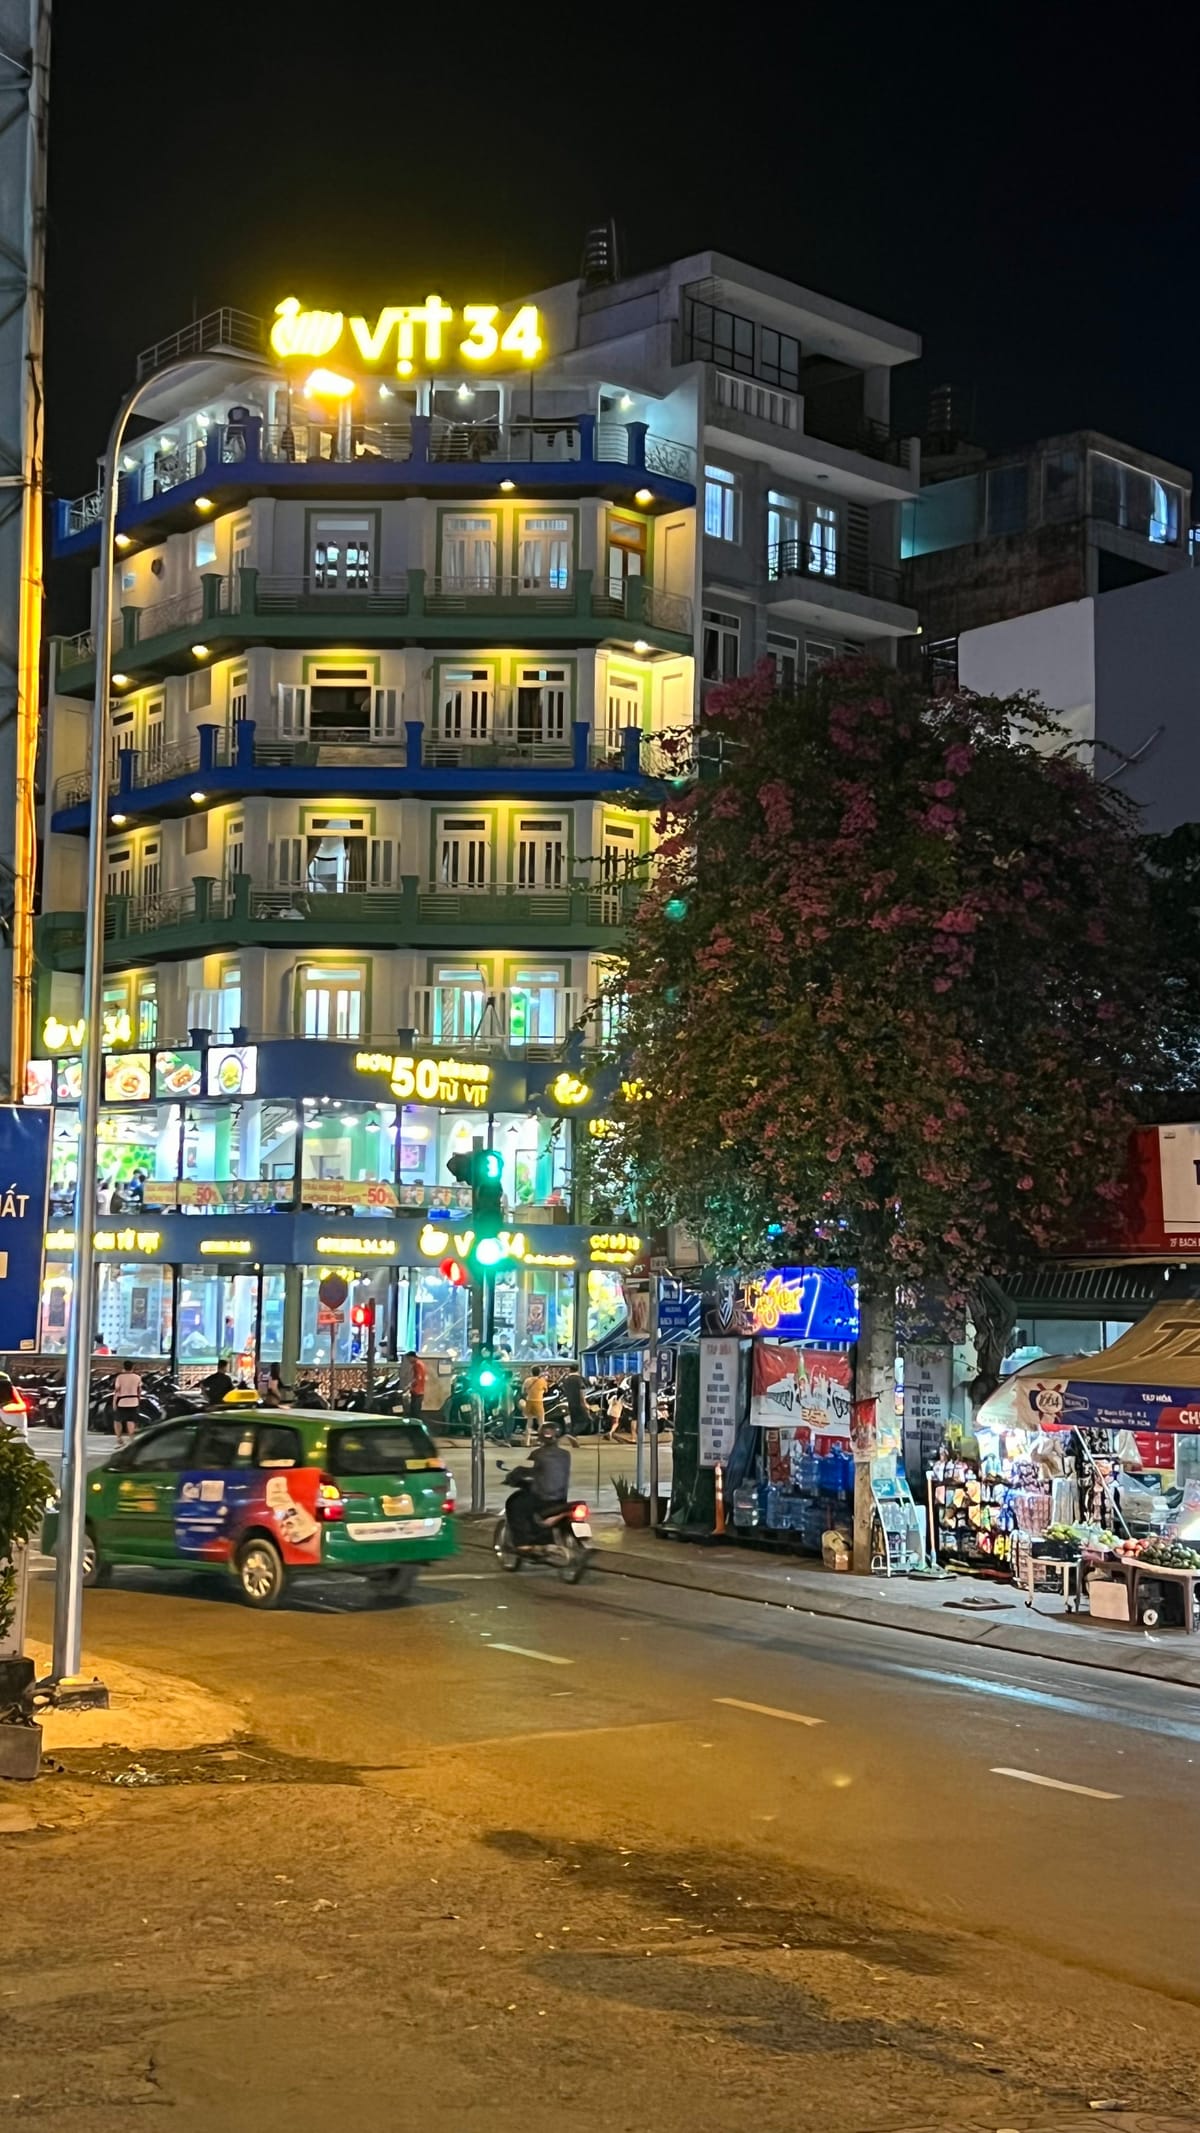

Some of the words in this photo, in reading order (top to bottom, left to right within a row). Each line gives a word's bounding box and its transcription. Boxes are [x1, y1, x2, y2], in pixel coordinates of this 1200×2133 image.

[460, 305, 542, 361] 34
[390, 1056, 439, 1099] 50
[0, 1183, 30, 1218] ẤT
[738, 1275, 803, 1329] Tiger
[1179, 1410, 1200, 1430] CH
